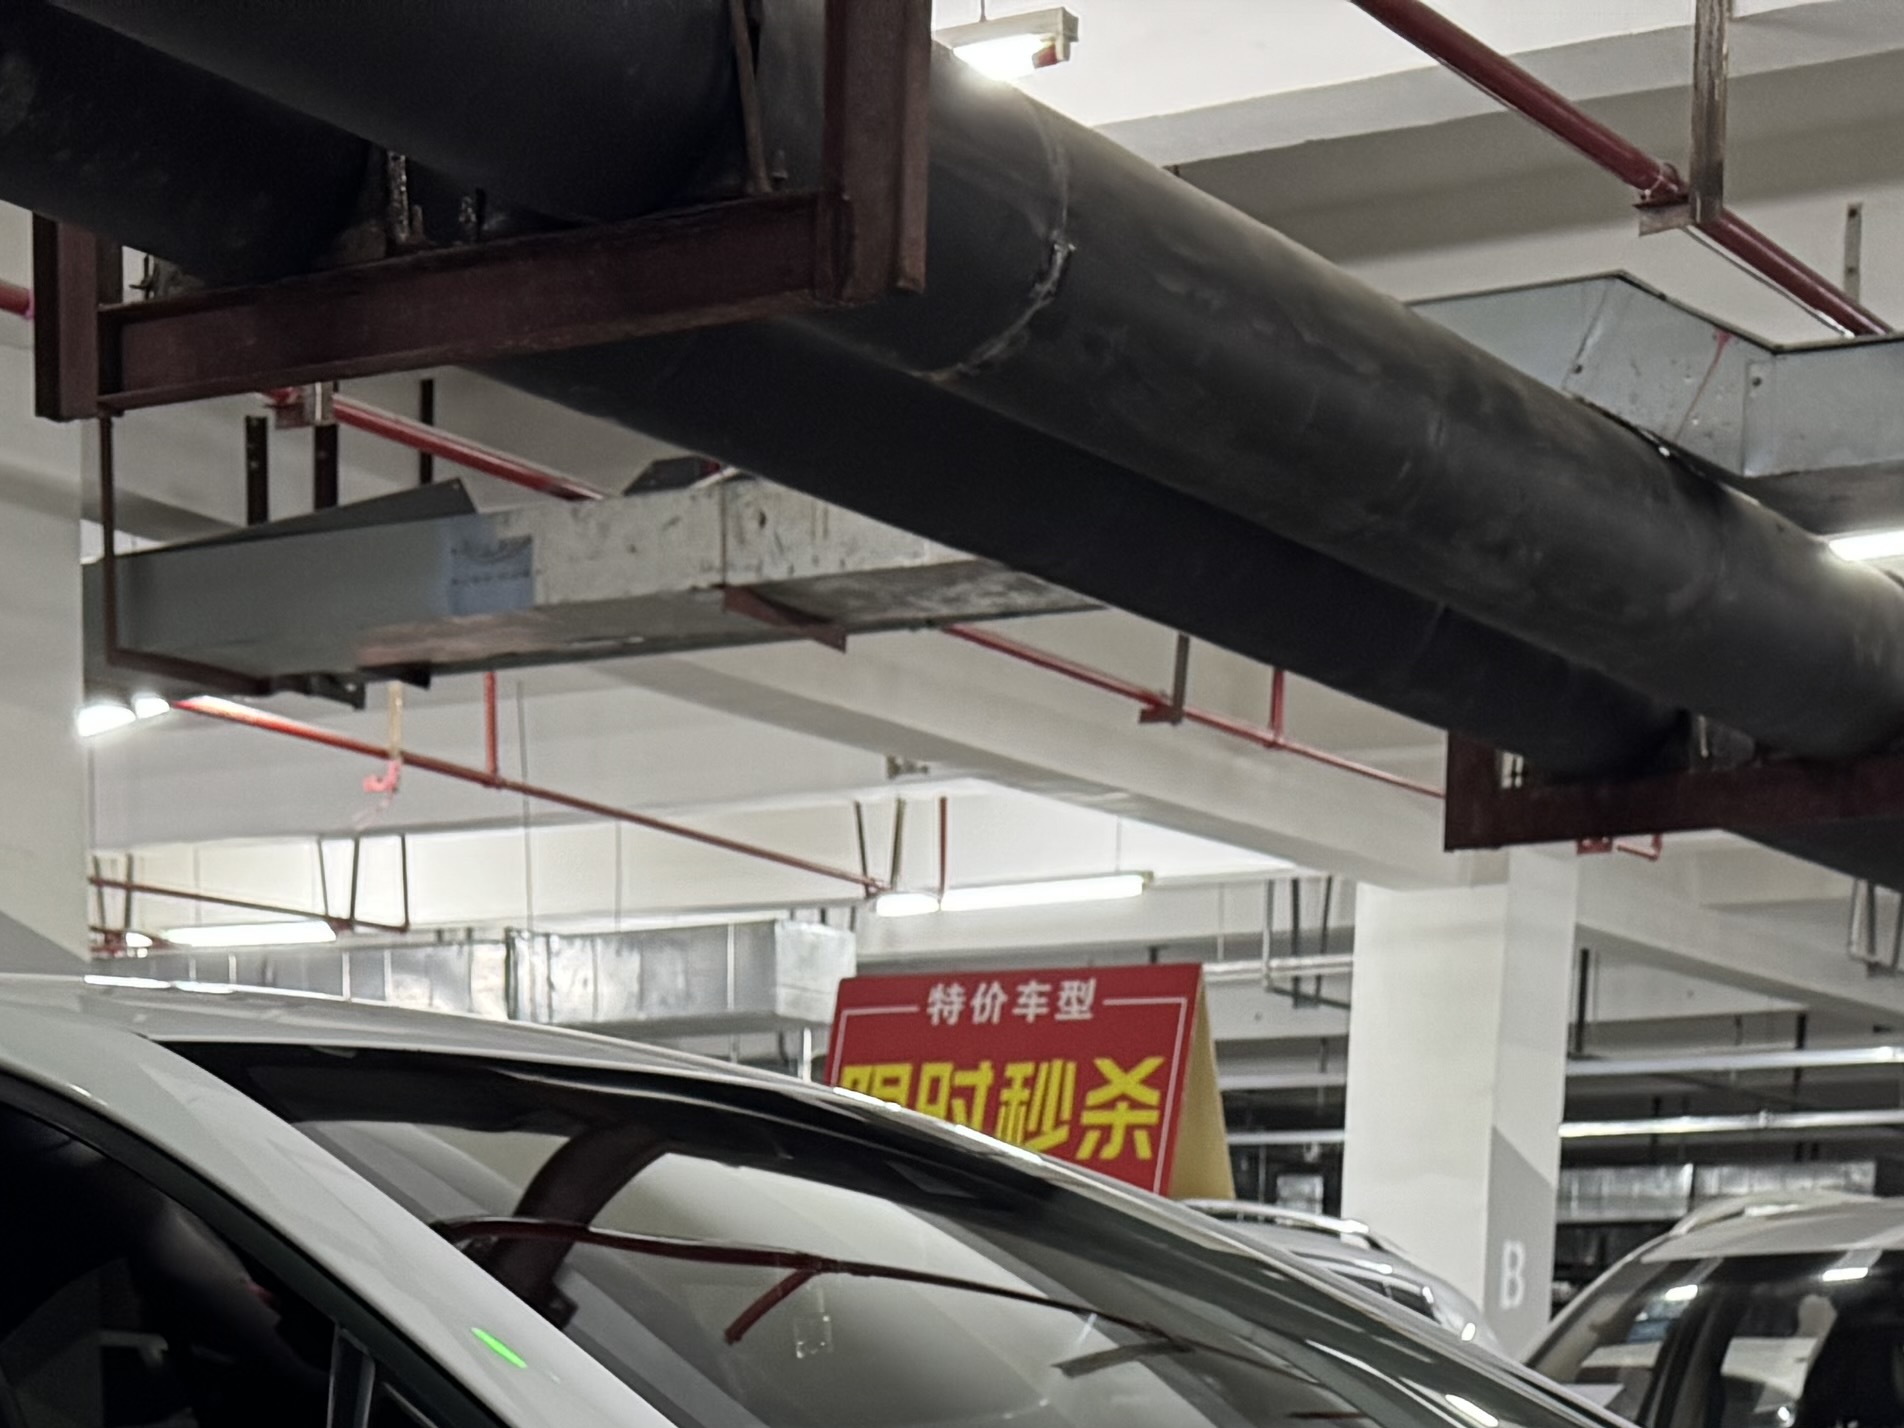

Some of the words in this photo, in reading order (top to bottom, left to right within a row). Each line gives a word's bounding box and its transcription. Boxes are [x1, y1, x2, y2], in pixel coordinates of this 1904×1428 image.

[925, 978, 1098, 1026] 特价车型
[1499, 1240, 1525, 1310] B
